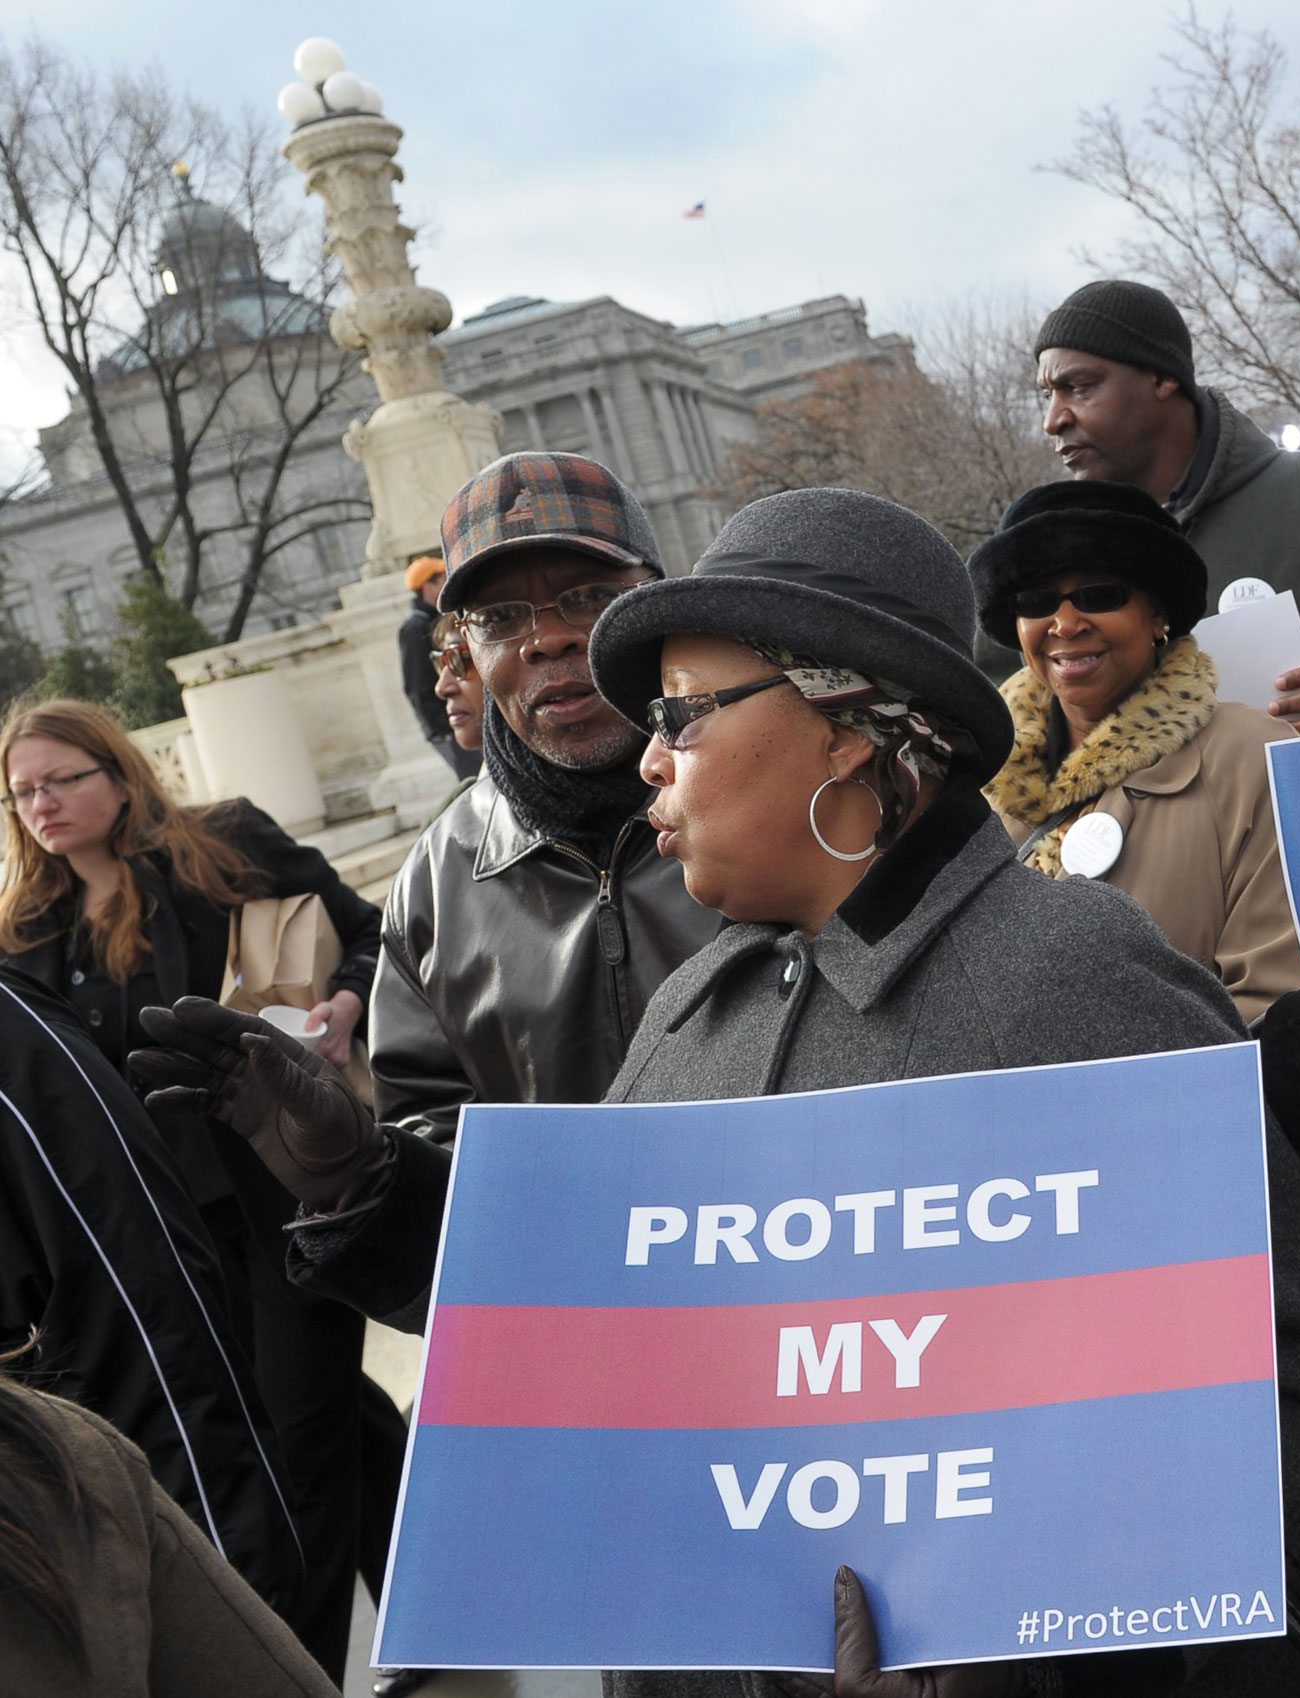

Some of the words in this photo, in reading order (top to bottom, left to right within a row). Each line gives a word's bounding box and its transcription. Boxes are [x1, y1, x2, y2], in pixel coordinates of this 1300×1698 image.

[624, 1169, 1099, 1266] PROTECT
[776, 1314, 949, 1397] MY
[709, 1446, 995, 1530] VOTE
[1016, 1590, 1275, 1645] #ProtectVRA
